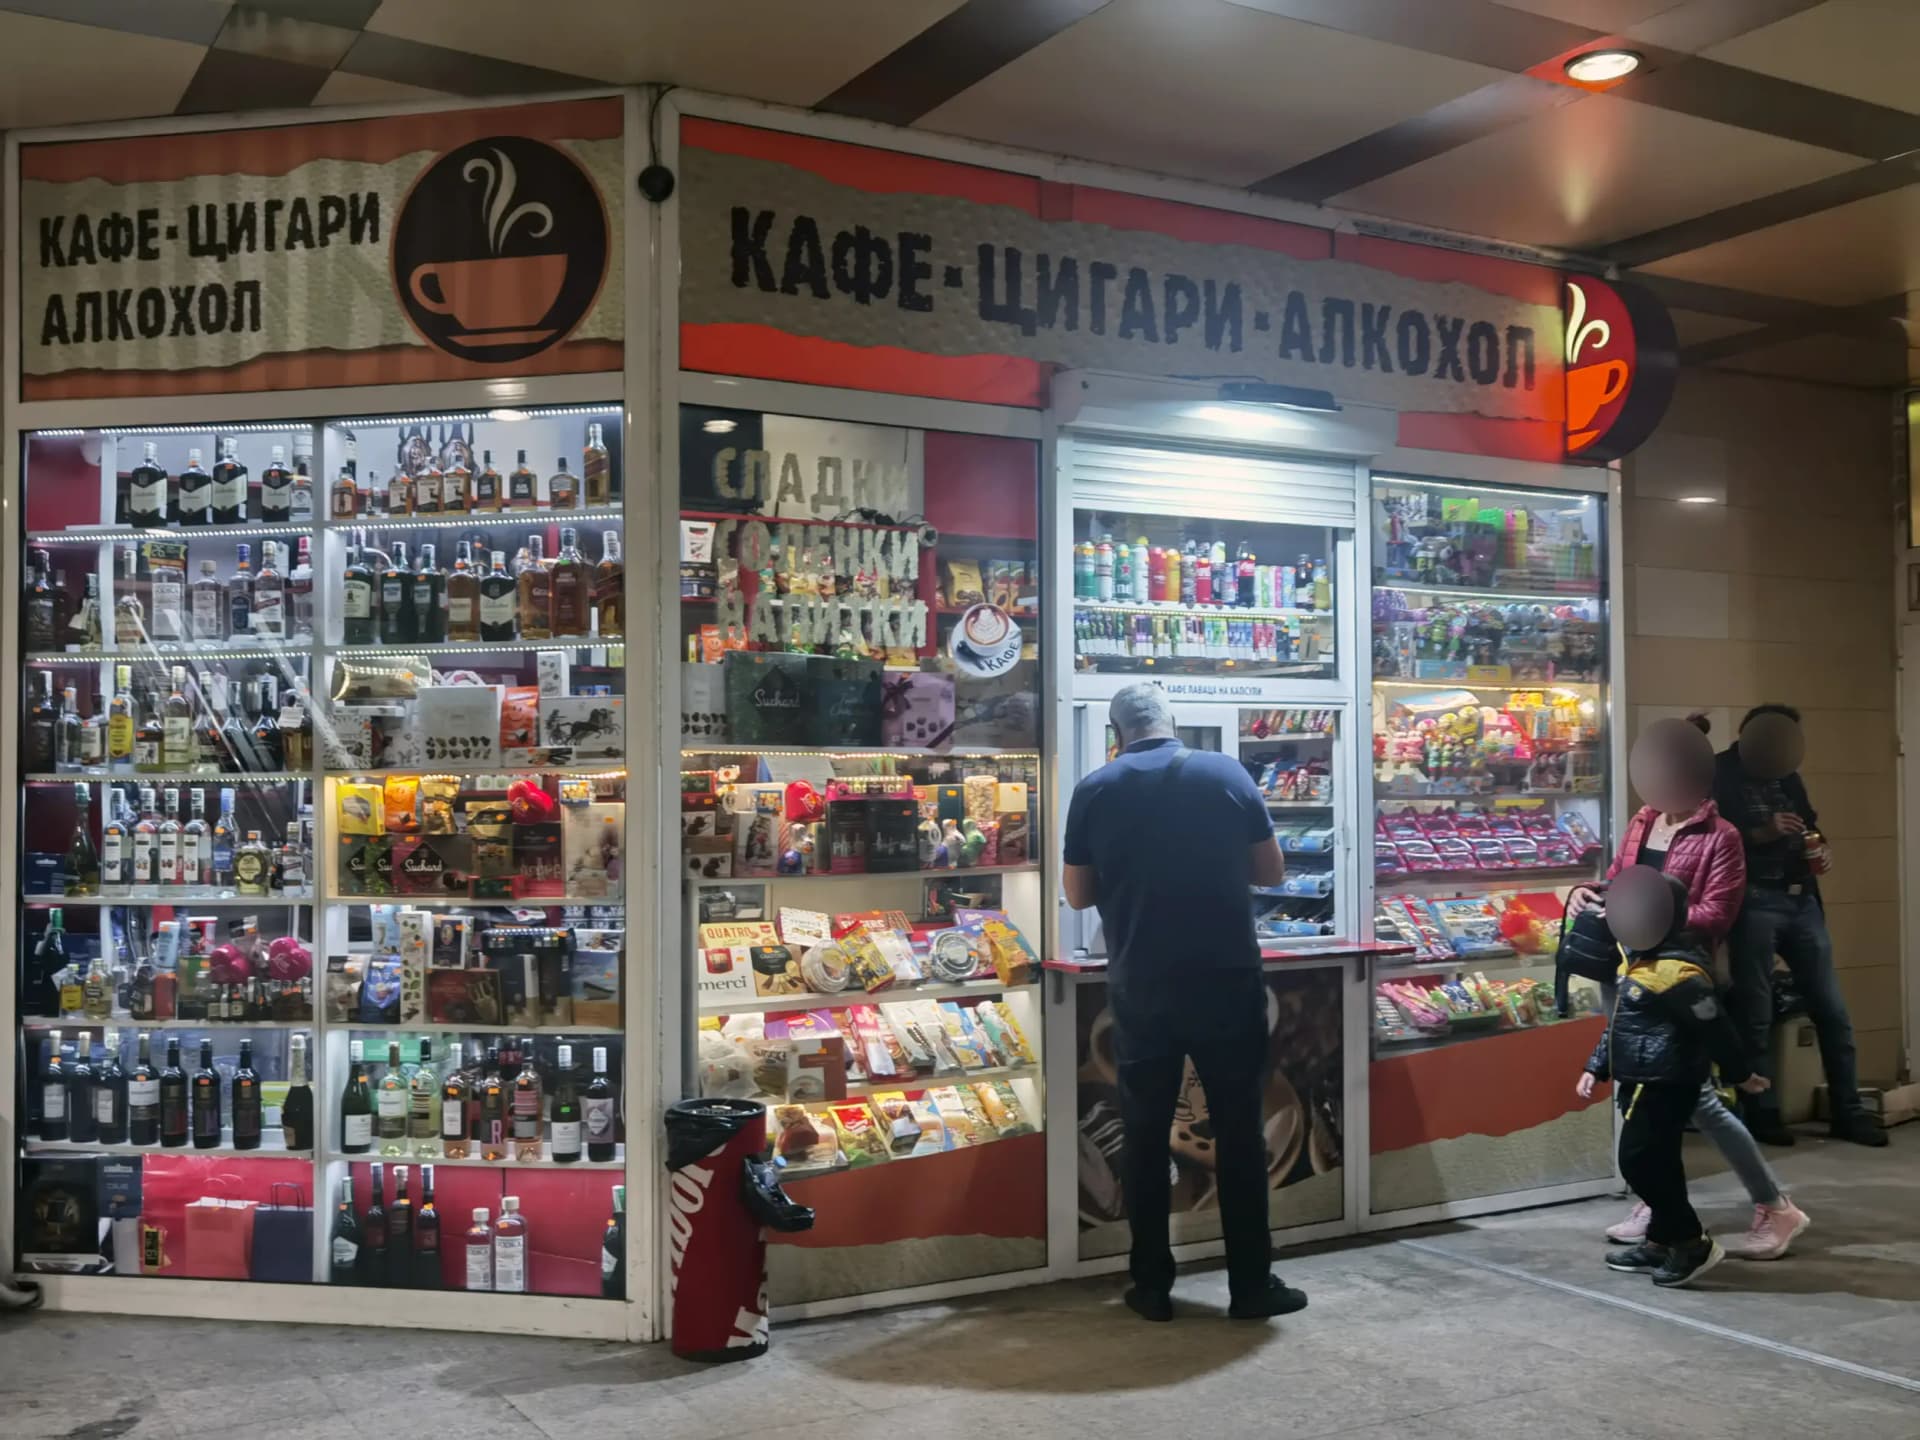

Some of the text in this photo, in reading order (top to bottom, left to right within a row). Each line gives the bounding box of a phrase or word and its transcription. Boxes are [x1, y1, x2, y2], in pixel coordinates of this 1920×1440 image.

[41, 280, 263, 346] АЛКОХОЛ
[984, 642, 1020, 671] КАФЕ
[404, 858, 442, 872] Suchard
